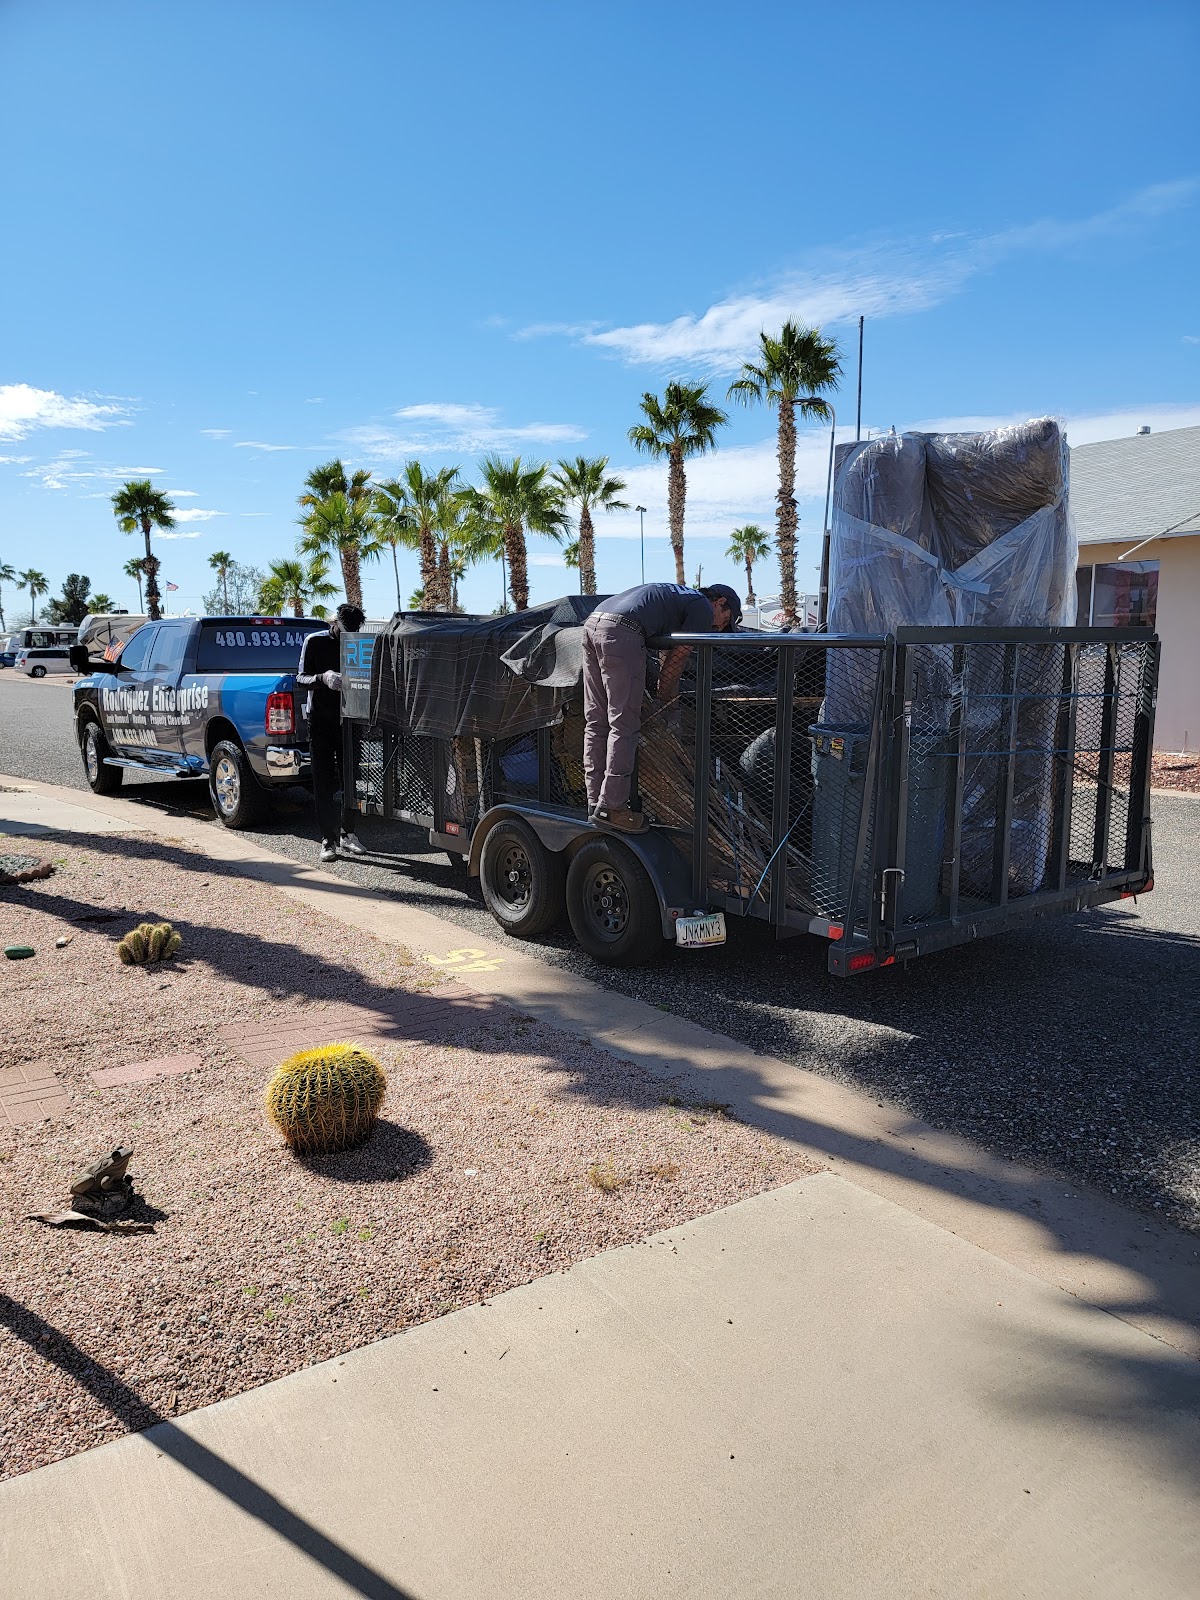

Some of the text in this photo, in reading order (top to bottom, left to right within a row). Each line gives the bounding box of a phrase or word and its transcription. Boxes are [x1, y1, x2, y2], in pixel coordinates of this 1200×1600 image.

[215, 631, 308, 647] 480.933.44
[103, 683, 208, 714] Rodriguez Enterprise
